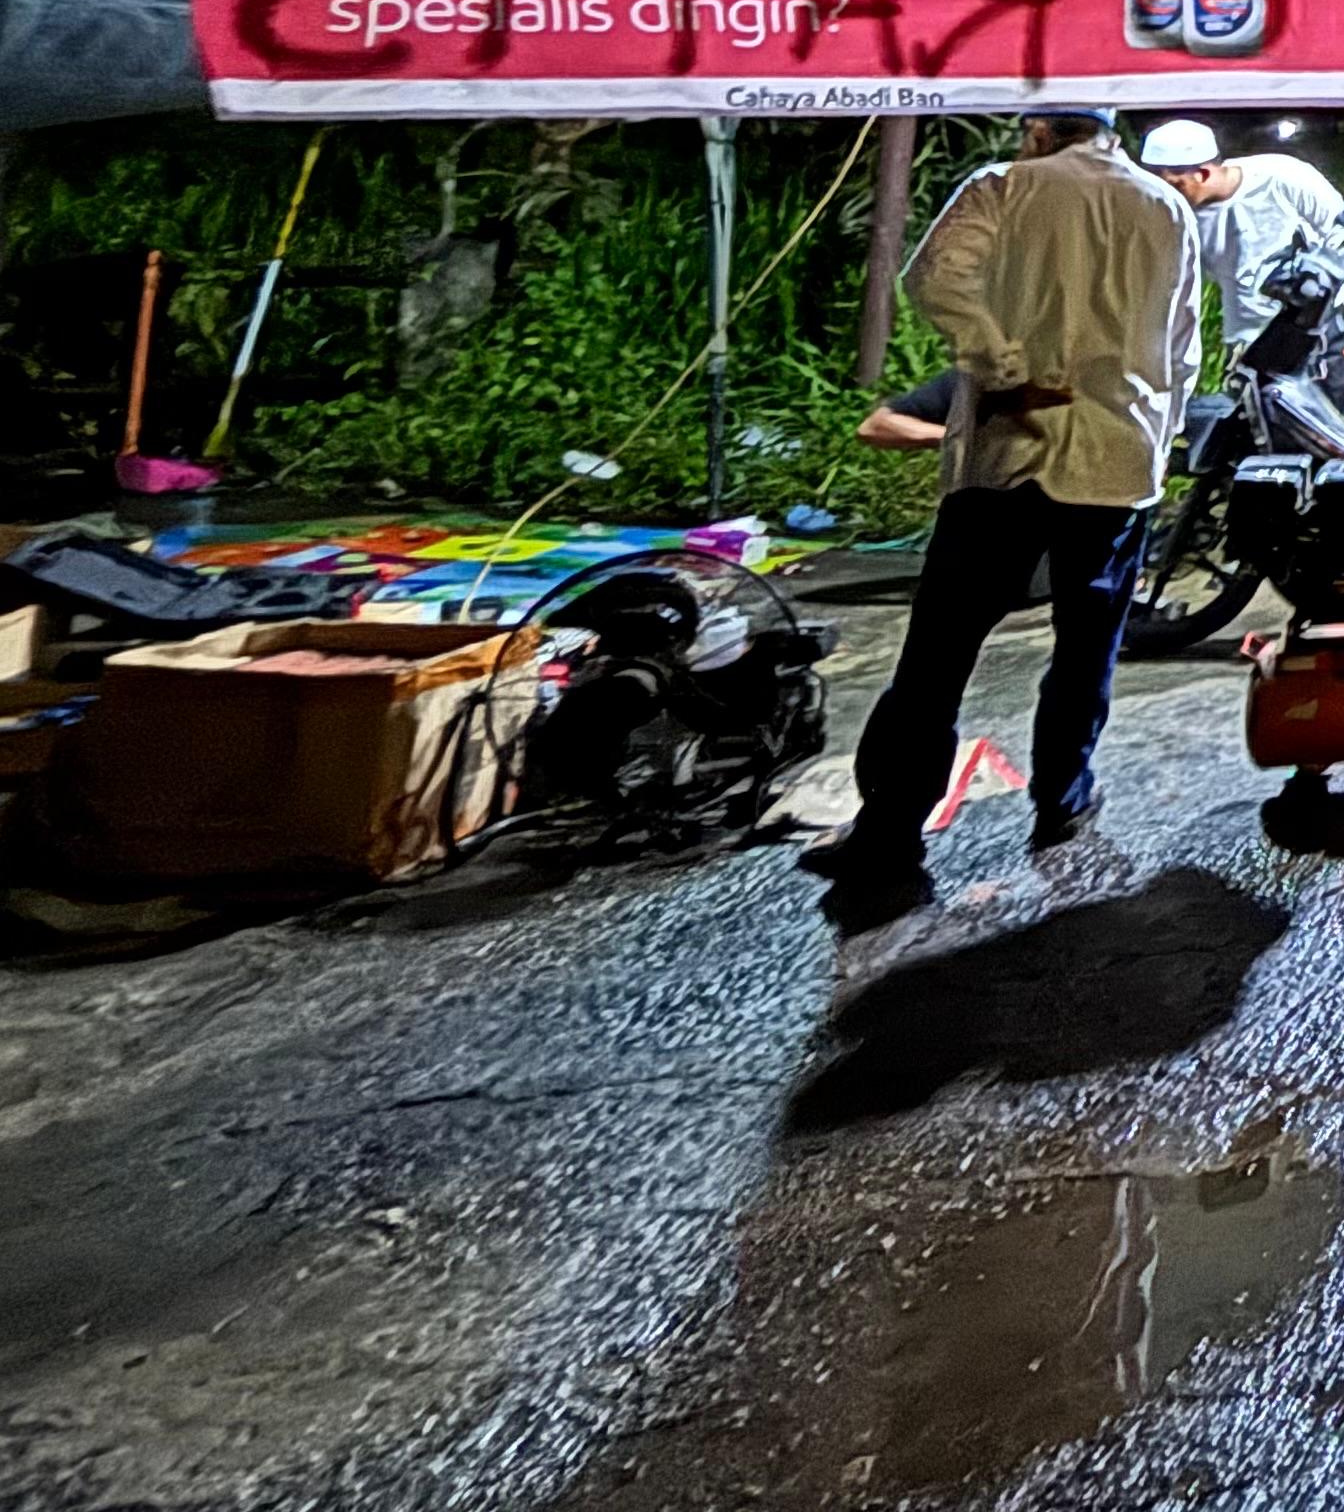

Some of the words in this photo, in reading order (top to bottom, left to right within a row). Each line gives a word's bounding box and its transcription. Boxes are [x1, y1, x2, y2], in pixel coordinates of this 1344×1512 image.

[726, 86, 816, 112] Cahaya
[822, 86, 891, 108] Abadi
[898, 88, 944, 107] Ban
